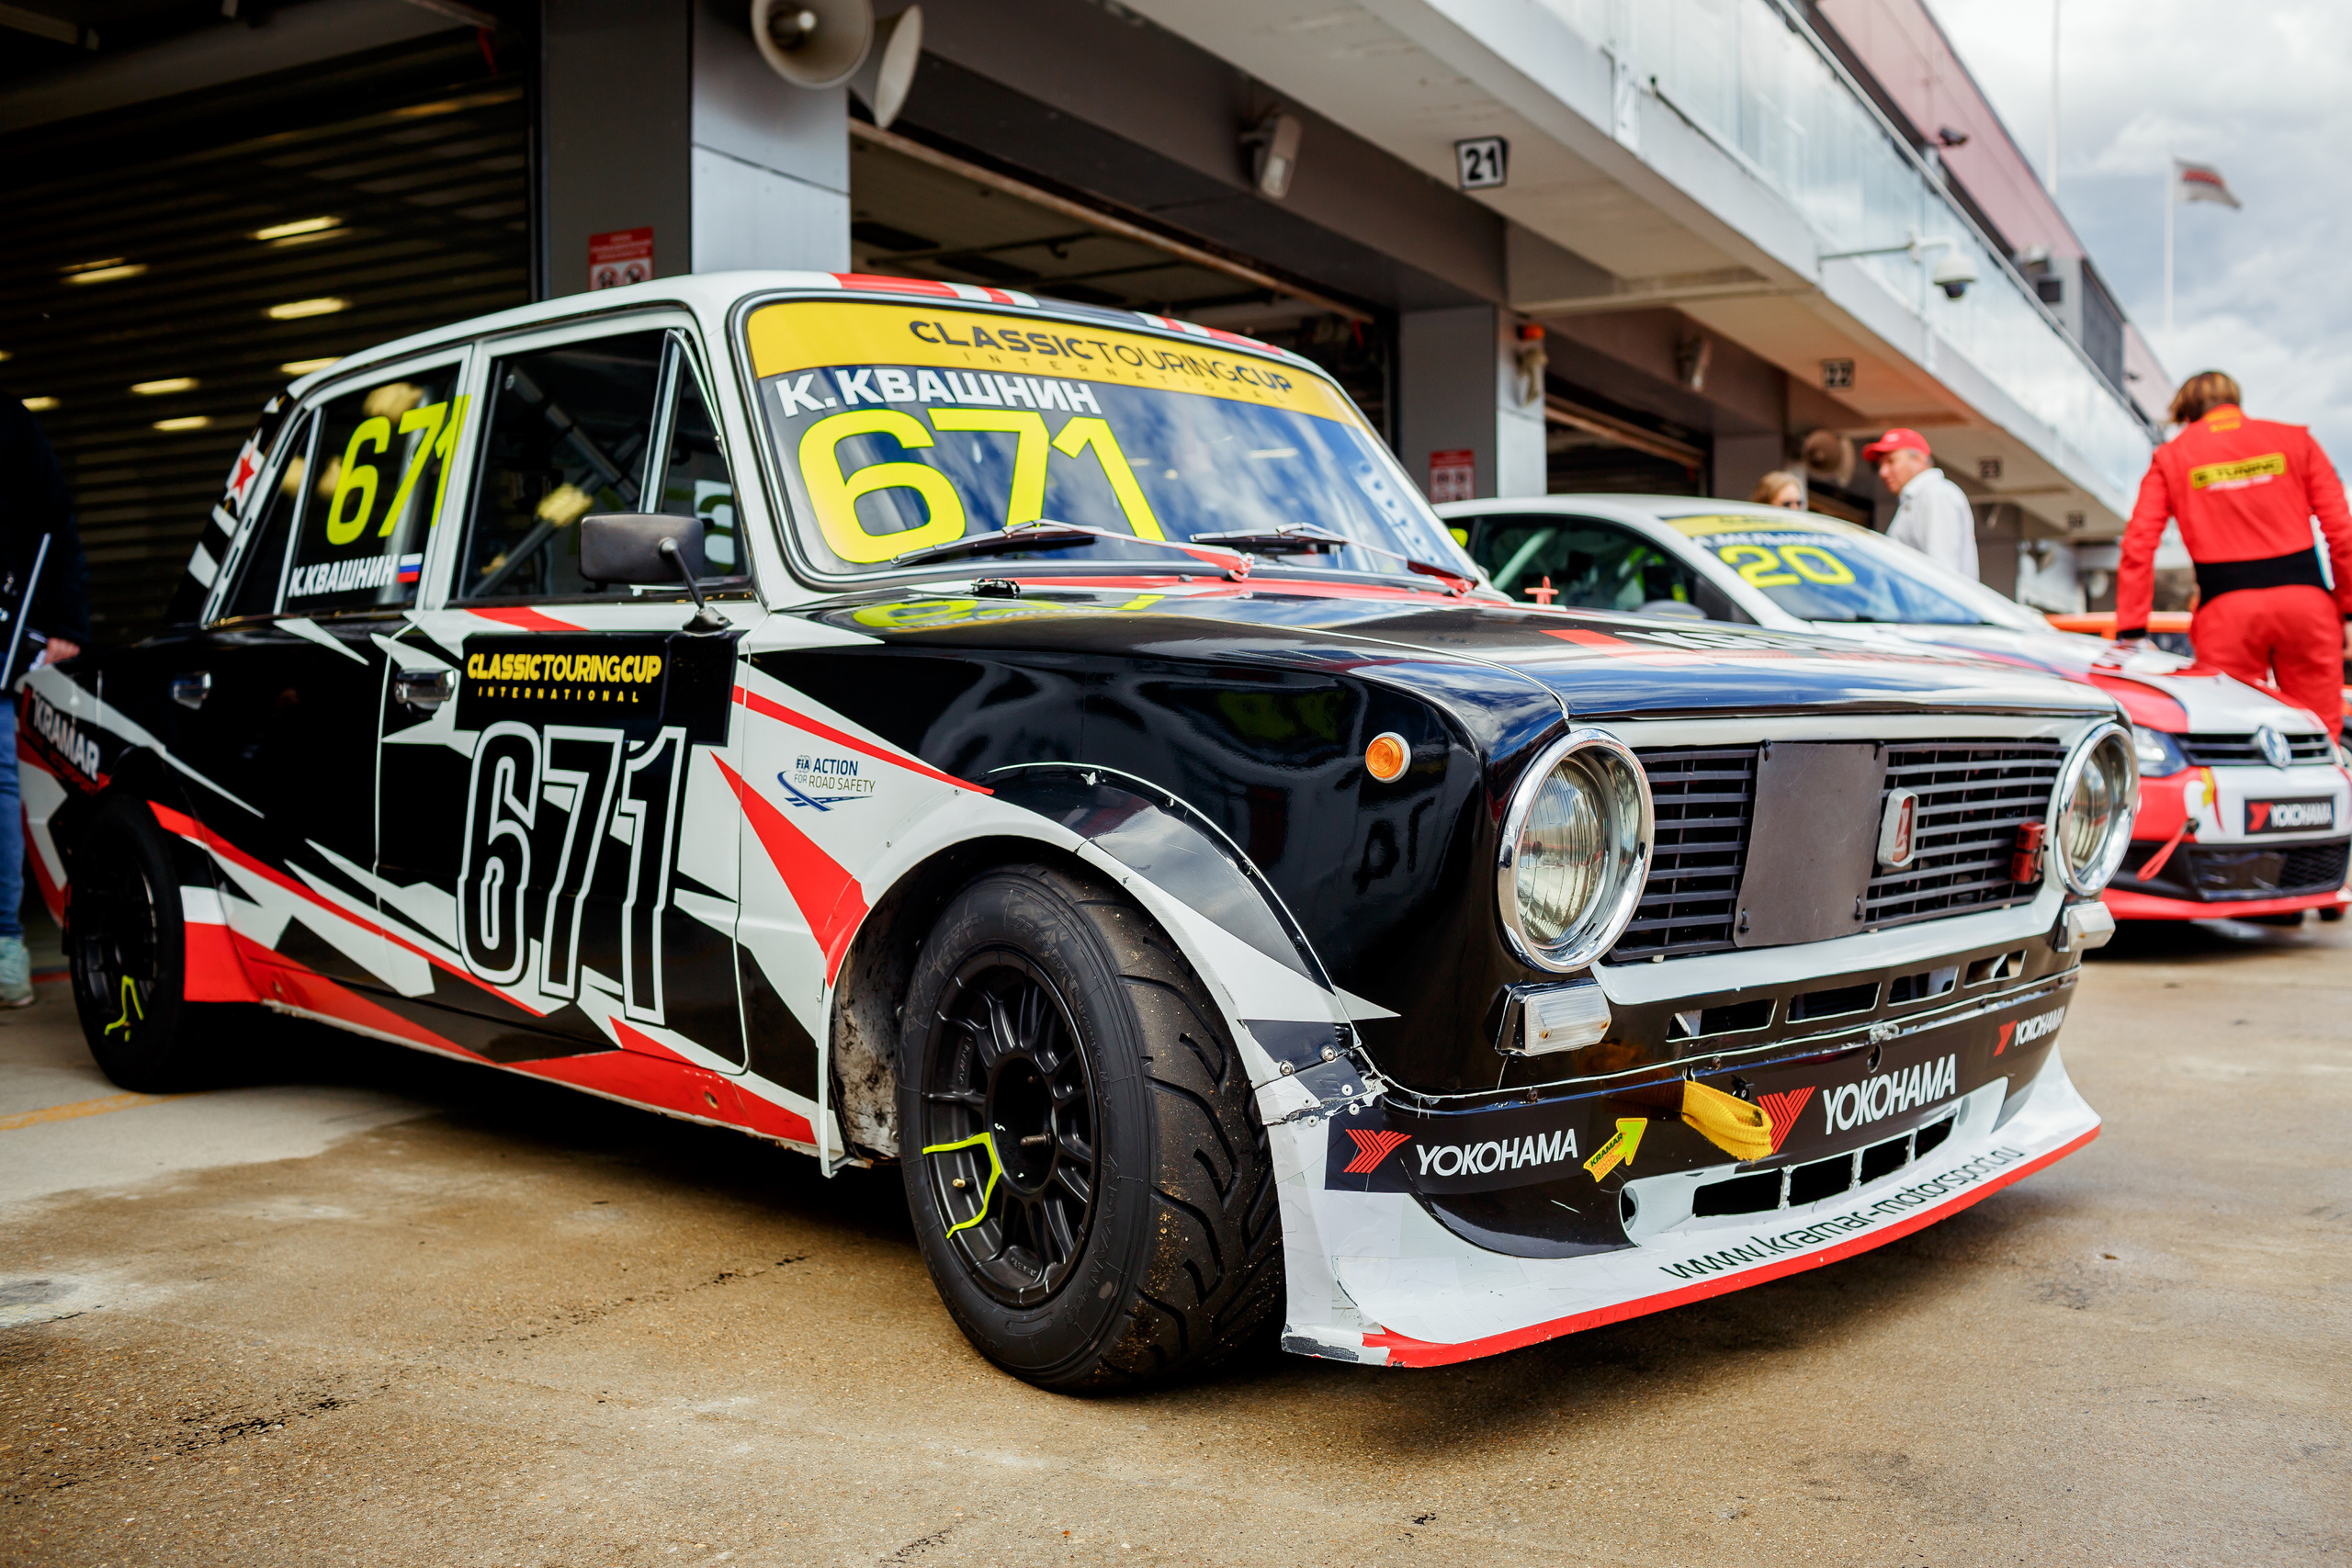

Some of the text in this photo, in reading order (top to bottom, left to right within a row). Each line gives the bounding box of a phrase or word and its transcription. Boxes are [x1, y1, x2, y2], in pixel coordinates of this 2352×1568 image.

[1465, 146, 1498, 181] 21
[910, 321, 1292, 394] CLASSICTOURINGCUP
[965, 353, 1284, 403] INTERNATIONAL
[326, 393, 471, 546] 671
[798, 408, 1166, 563] 671
[1719, 544, 1856, 590] 20
[467, 653, 662, 683] CLASSICTOURINGCUP
[478, 686, 639, 703] INTERNATIONAL
[34, 696, 100, 783] KRAMAR
[794, 773, 876, 793] FOR ROAD SAFETY
[813, 758, 858, 776] ACTION
[2269, 802, 2333, 828] YOKOHAMA
[458, 720, 687, 1026] 671
[2014, 1005, 2065, 1047] YOKOHAMA
[1822, 1054, 1957, 1135] YOKOHAMA
[1416, 1129, 1578, 1177] YOKOHAMA
[1589, 1132, 1623, 1167] KRAMAR
